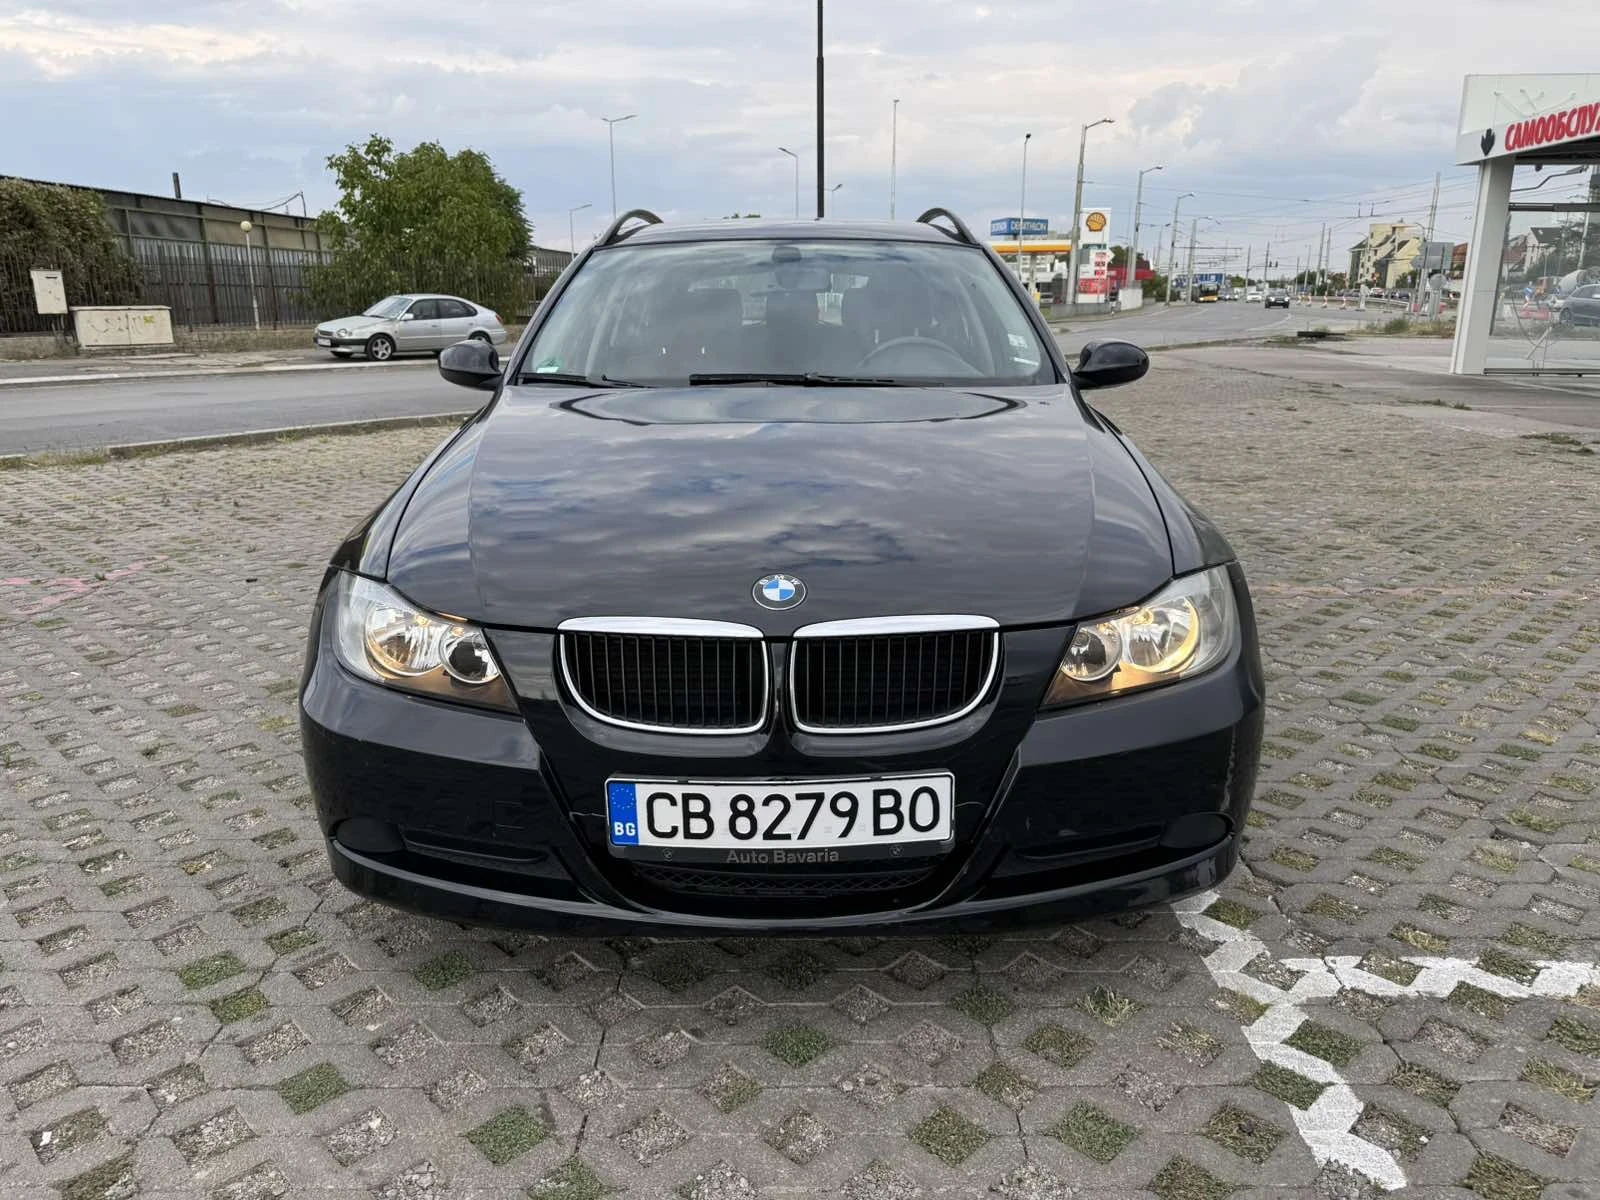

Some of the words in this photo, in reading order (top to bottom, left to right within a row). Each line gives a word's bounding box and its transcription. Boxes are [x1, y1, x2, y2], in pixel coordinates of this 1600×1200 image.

[1504, 102, 1600, 152] САМООБСЛУ
[613, 822, 636, 836] BG
[646, 791, 715, 840] CB
[728, 791, 860, 841] 8279
[872, 786, 941, 837] BO
[727, 849, 769, 864] Auto
[773, 848, 840, 864] Bavaria
